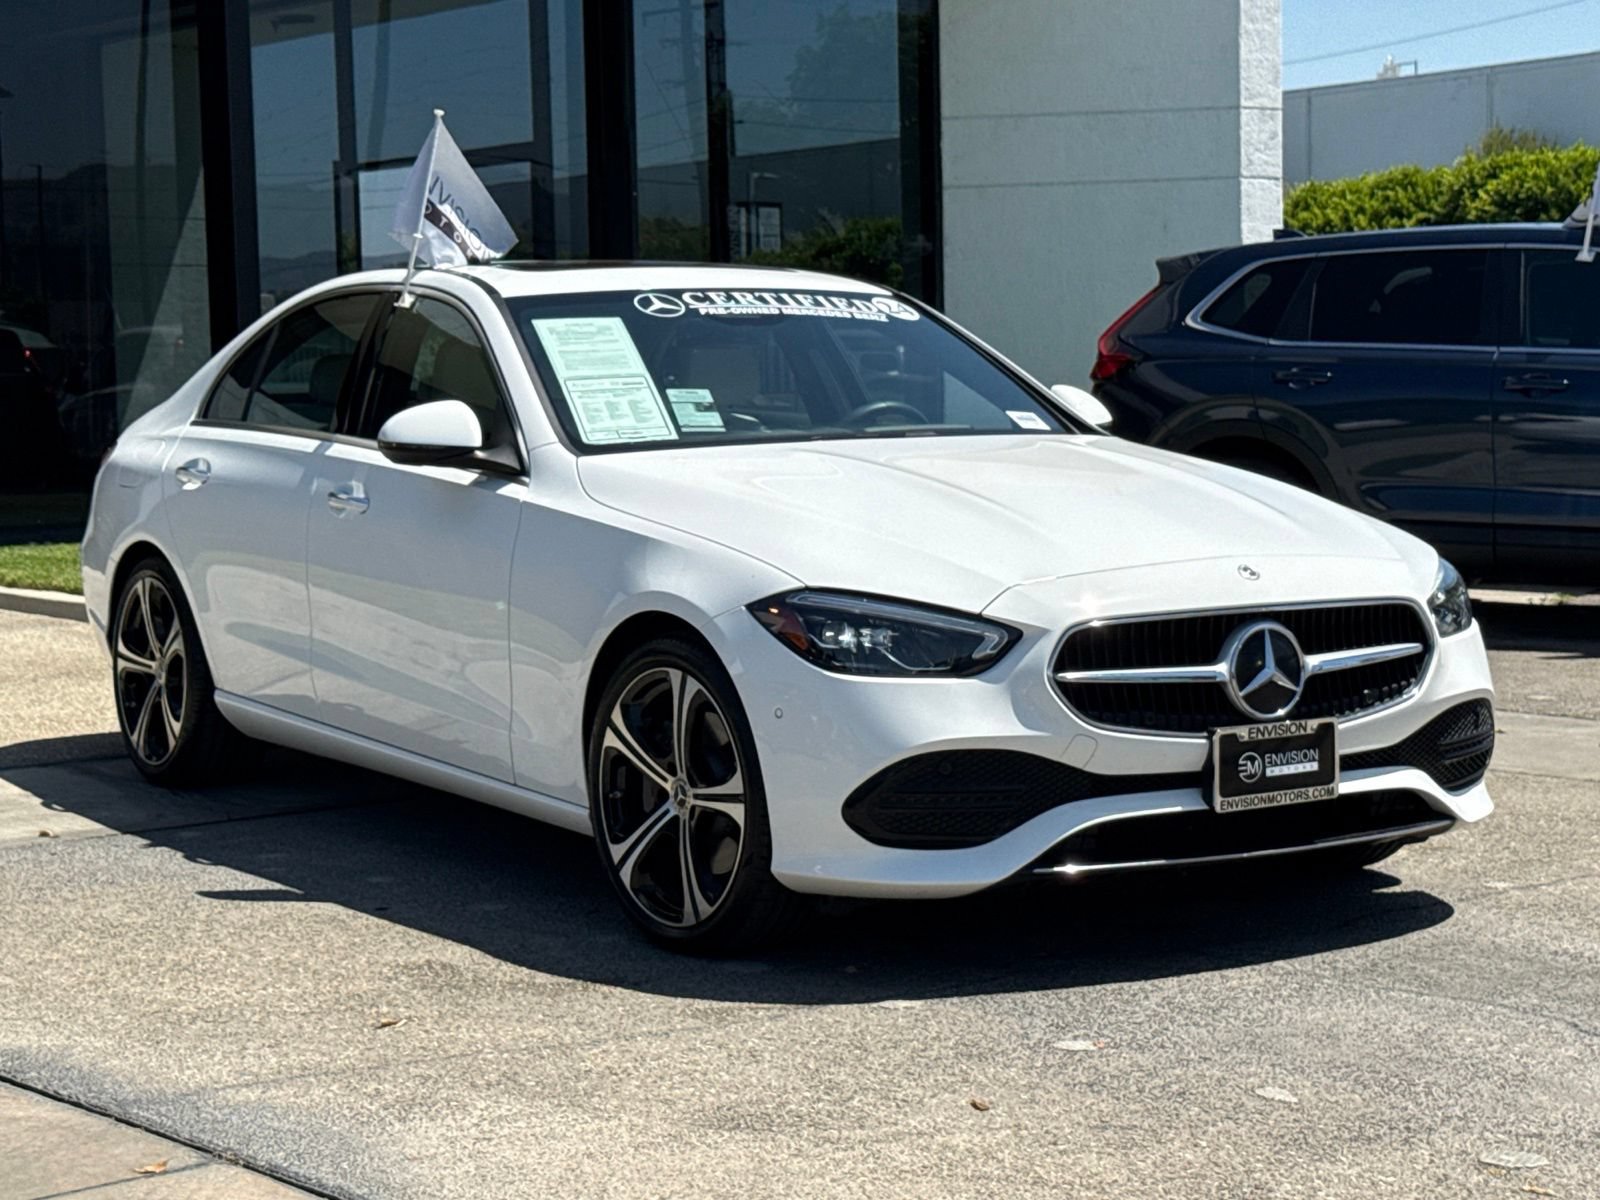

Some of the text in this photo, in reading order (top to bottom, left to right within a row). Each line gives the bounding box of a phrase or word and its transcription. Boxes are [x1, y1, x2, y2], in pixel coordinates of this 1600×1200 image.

[682, 291, 878, 312] CERTIFIED
[698, 307, 780, 316] PRE-OWNED
[1248, 721, 1307, 740] ENVISION
[1265, 748, 1319, 766] ENVISION
[1269, 764, 1315, 774] MOTORS
[1220, 786, 1334, 811] ENVISIONMOTORS.COM
